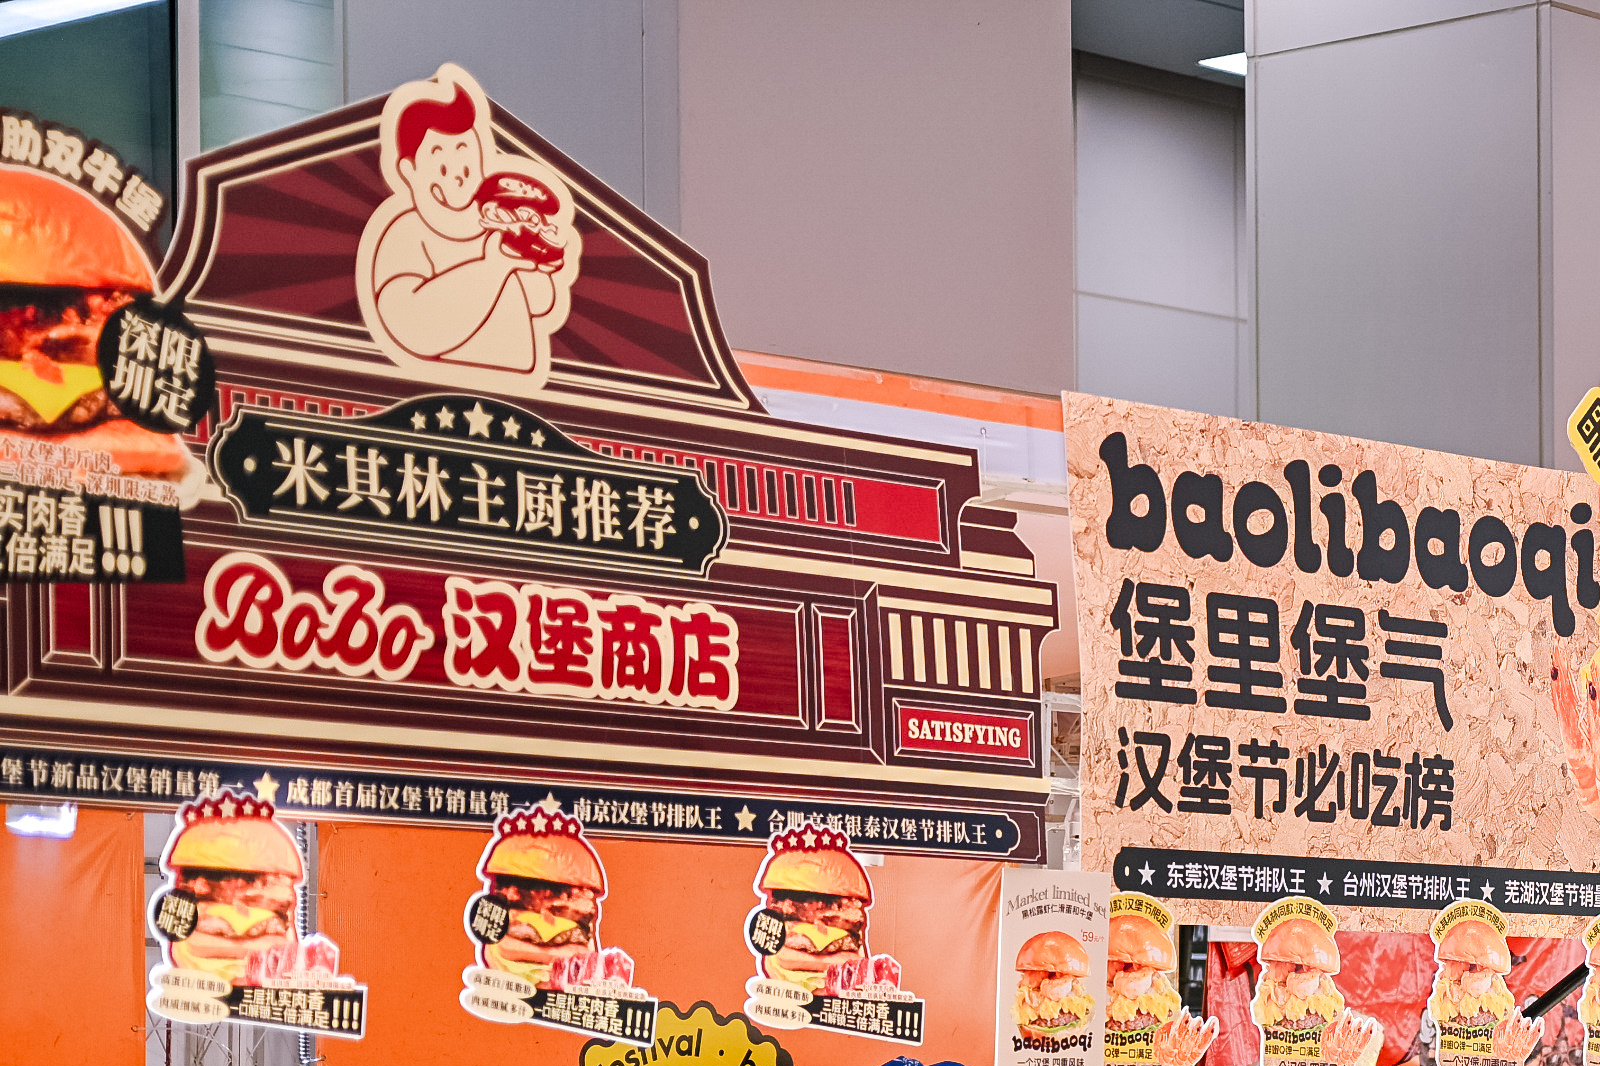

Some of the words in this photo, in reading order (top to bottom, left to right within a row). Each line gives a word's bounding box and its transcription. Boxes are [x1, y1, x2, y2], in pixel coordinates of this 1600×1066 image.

[272, 437, 679, 548] 米其林主厨推荐
[1098, 431, 1600, 637] baolibaoqi
[0, 532, 96, 576] 倍满足
[450, 586, 731, 702] 汉堡商店
[1110, 577, 1455, 731] 堡里堡气
[908, 717, 1022, 748] SATISFYING
[1114, 726, 1455, 832] 汉堡节必吃榜
[573, 797, 723, 830] 南京汉堡节排队王
[1166, 862, 1307, 895] 东莞汉堡节排队王
[1343, 870, 1472, 902] 台州汉堡节排队王
[1006, 887, 1049, 917] Market
[1052, 885, 1092, 908] limited
[1093, 900, 1109, 920] set
[822, 998, 890, 1020] 三层扎实肉香
[1012, 1031, 1094, 1054] baolibaoqi
